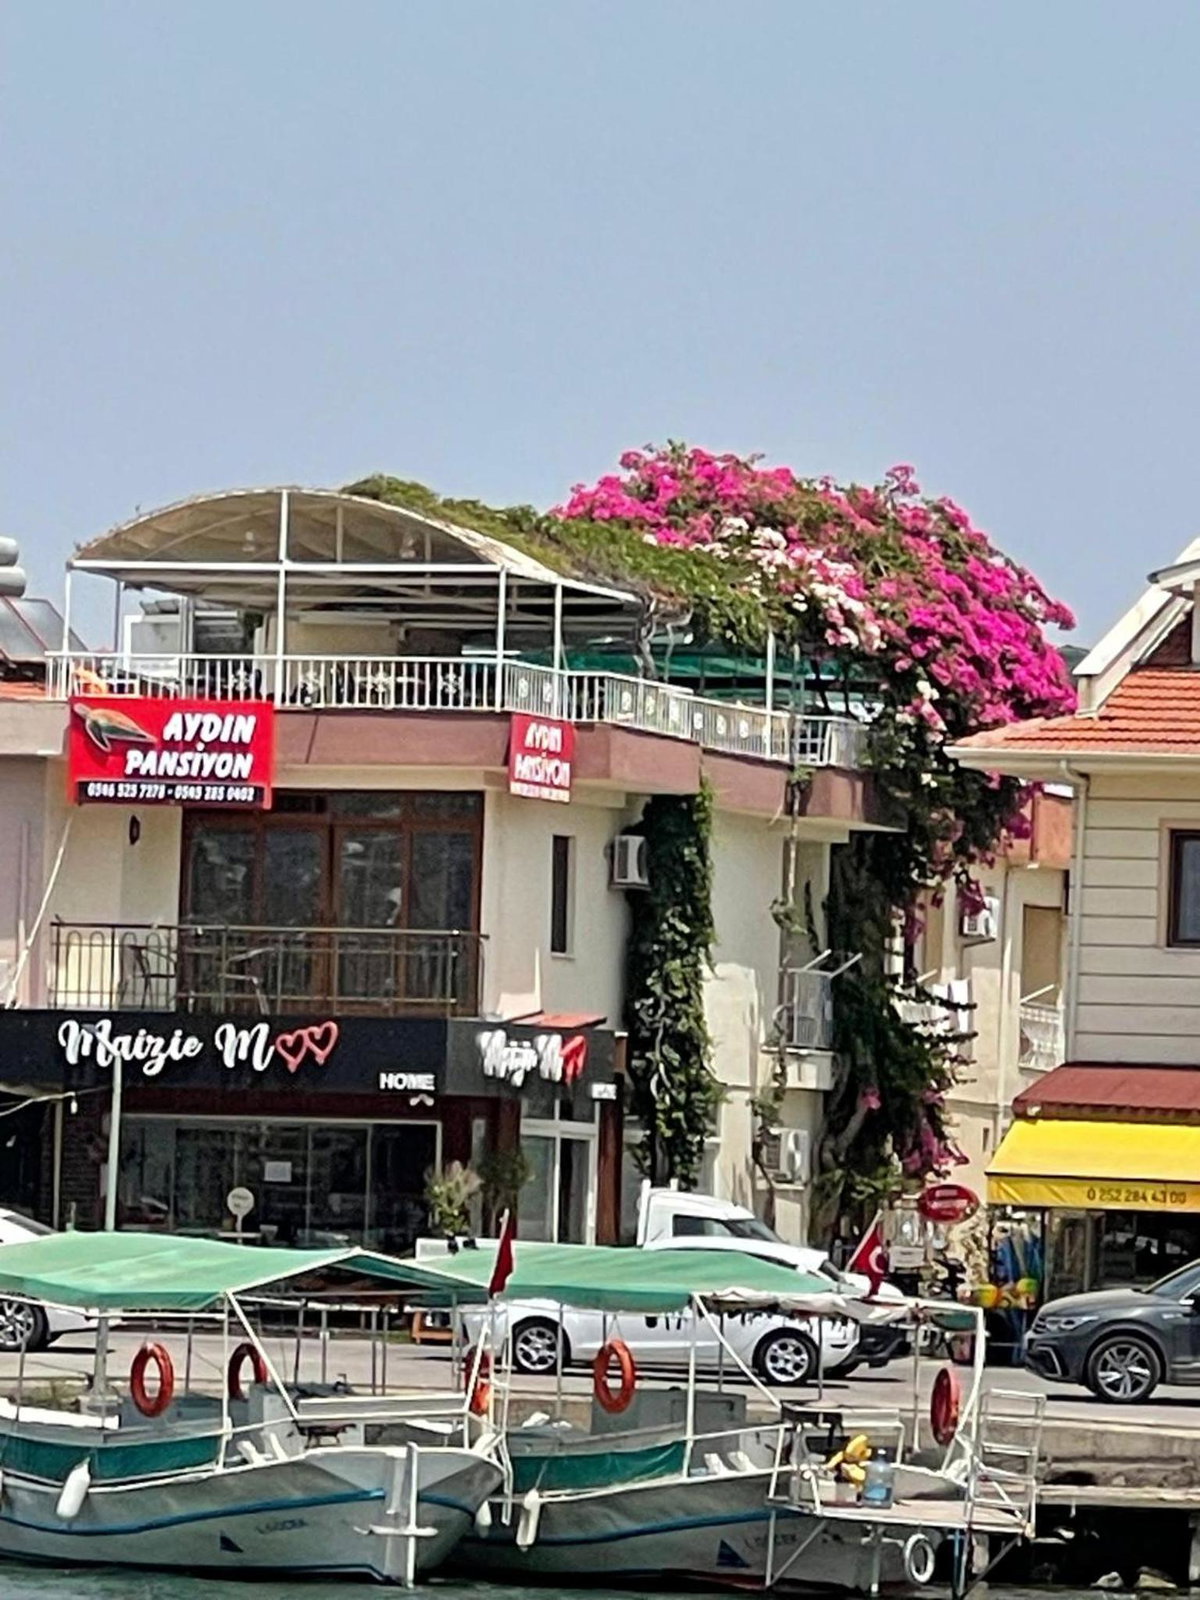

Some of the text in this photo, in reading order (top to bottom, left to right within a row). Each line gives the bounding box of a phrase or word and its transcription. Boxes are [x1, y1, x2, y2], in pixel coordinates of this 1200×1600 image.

[162, 712, 256, 744] AYDIN
[124, 742, 254, 779] PANSİYON
[57, 1018, 276, 1077] Maizie M
[379, 1071, 436, 1091] HOME
[1086, 1186, 1097, 1201] 0
[1099, 1186, 1122, 1202] 252
